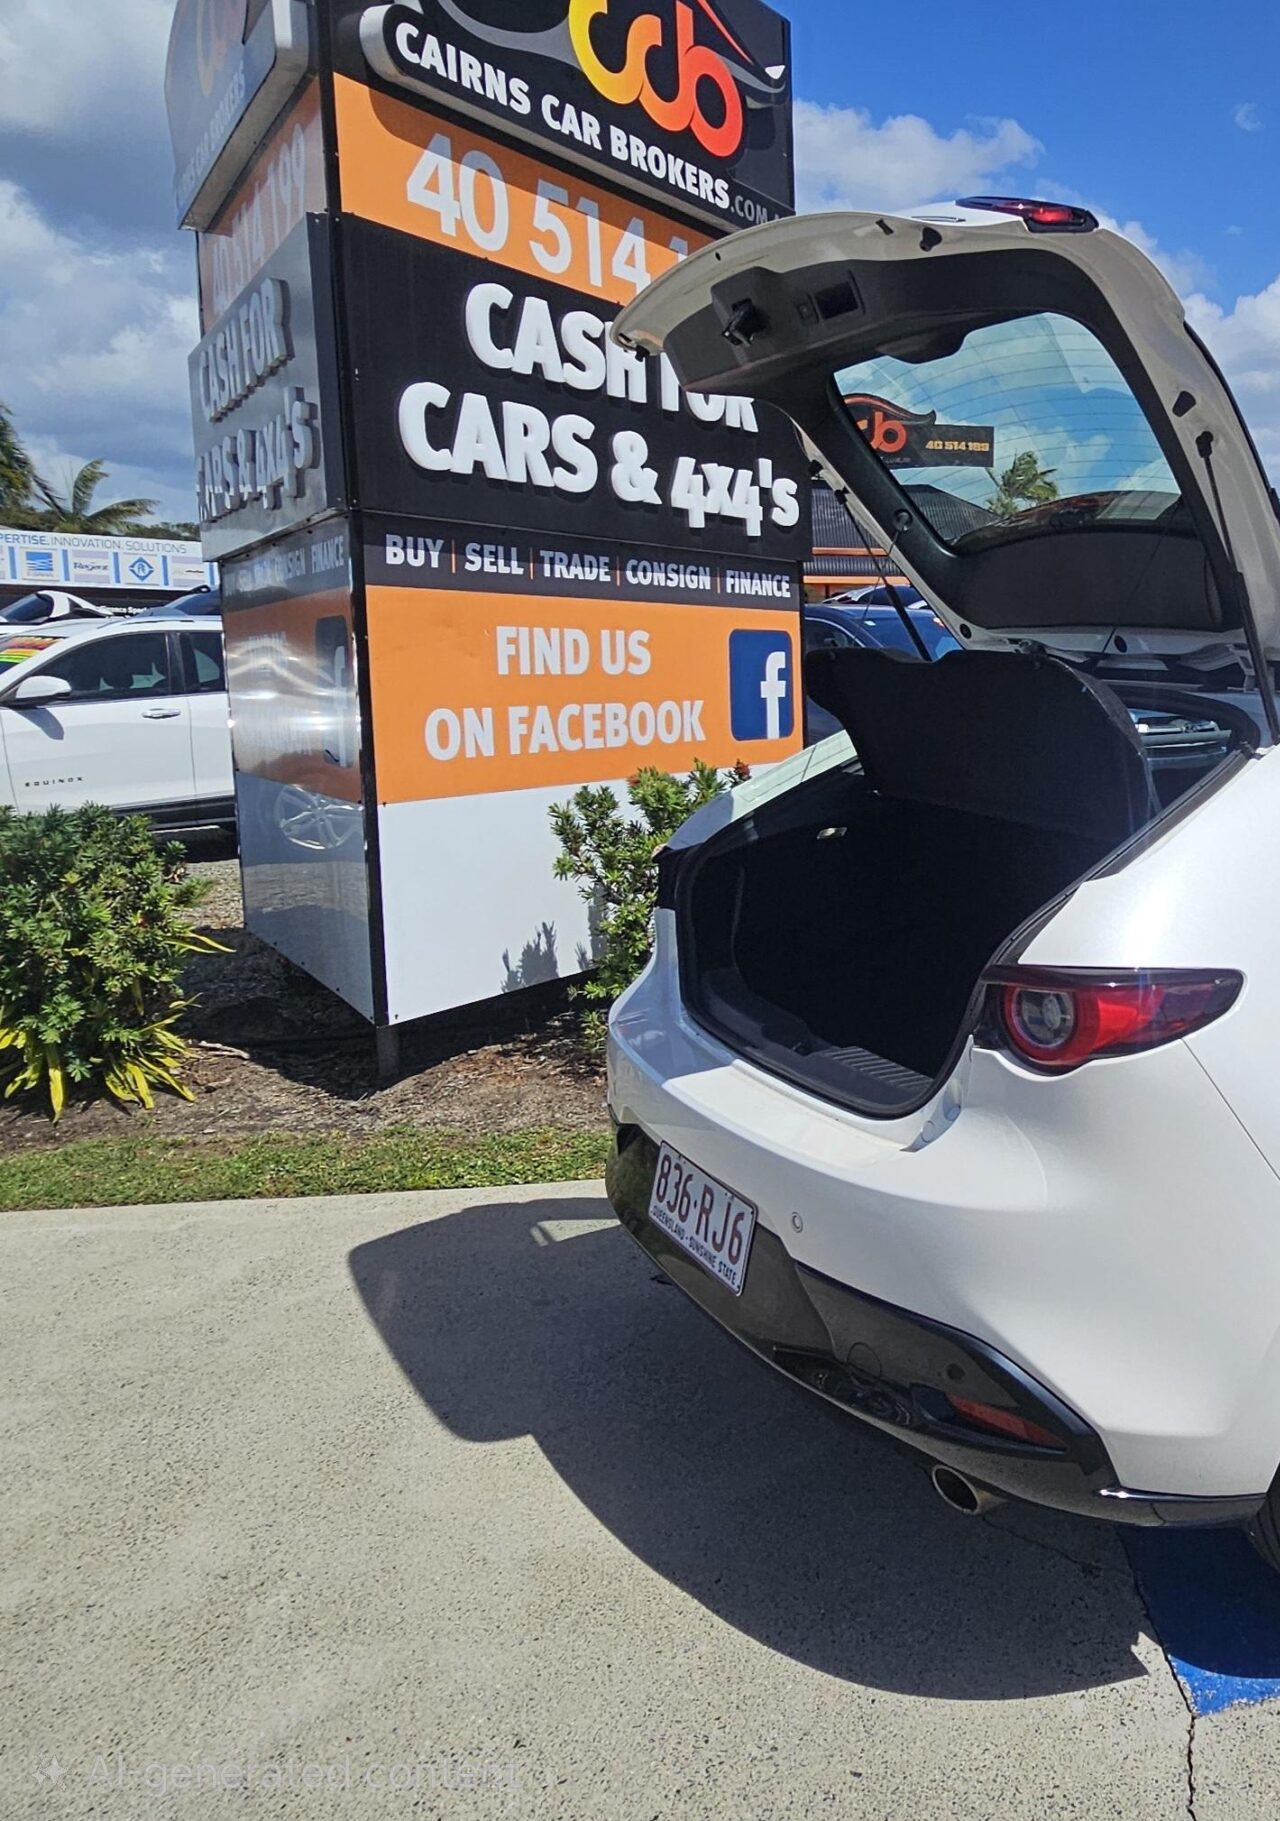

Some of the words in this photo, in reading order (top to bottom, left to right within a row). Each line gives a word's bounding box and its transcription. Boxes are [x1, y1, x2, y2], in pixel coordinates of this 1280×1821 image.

[395, 21, 531, 115] CAIRNS
[541, 94, 602, 150] CAR
[407, 133, 508, 251] 40
[529, 179, 651, 295] 514
[200, 319, 243, 422] CASH
[239, 278, 287, 386] FOR
[465, 283, 648, 404] CASH
[399, 381, 597, 492] CARS
[611, 430, 662, 505] &
[125, 541, 186, 554] SOLUTIONS
[311, 536, 344, 573] FINANCE
[386, 534, 443, 568] BUY
[465, 543, 524, 575] SELL
[540, 550, 610, 582] TRADE
[626, 559, 711, 590] CONSIGN
[726, 570, 791, 598] FINANCE
[496, 626, 589, 675] FIND
[601, 630, 651, 675] US
[424, 707, 494, 760] ON
[508, 700, 706, 756] FACEBOOK
[653, 1205, 685, 1240] QUEENSLAND
[689, 1233, 717, 1268] SUNSHINE
[718, 1261, 738, 1286] STATE
